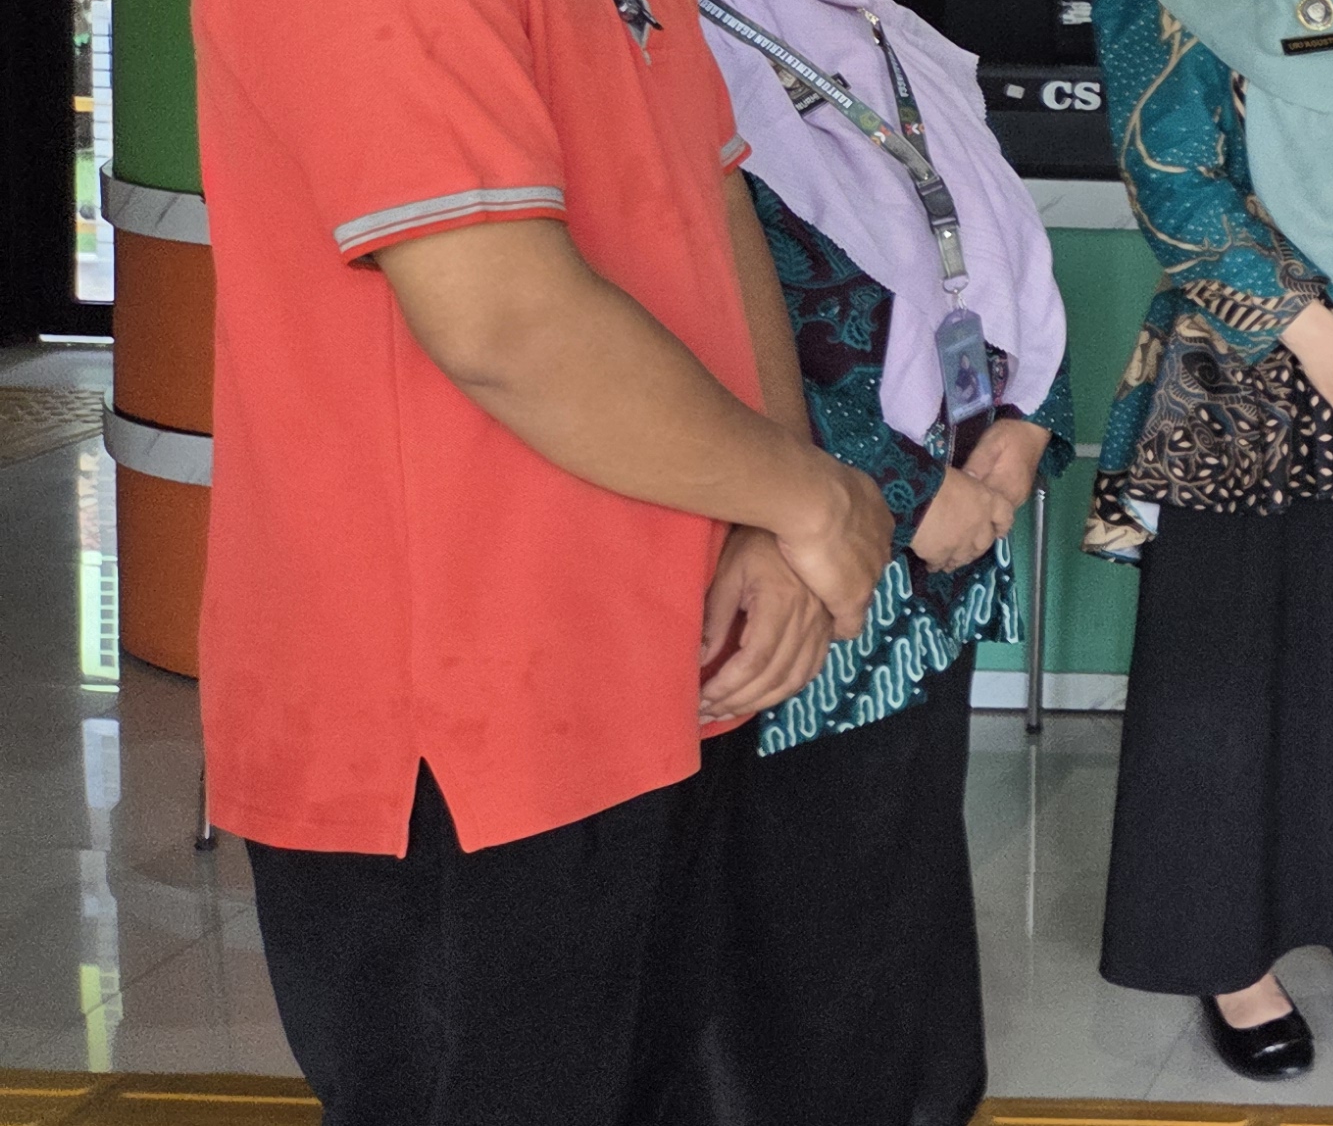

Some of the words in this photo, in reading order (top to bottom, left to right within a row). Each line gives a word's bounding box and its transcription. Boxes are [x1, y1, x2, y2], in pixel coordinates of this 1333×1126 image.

[722, 12, 757, 39] AGAMA
[755, 35, 818, 81] KEMENTERIAN
[815, 75, 853, 109] KANTOR
[1042, 80, 1102, 111] CS
